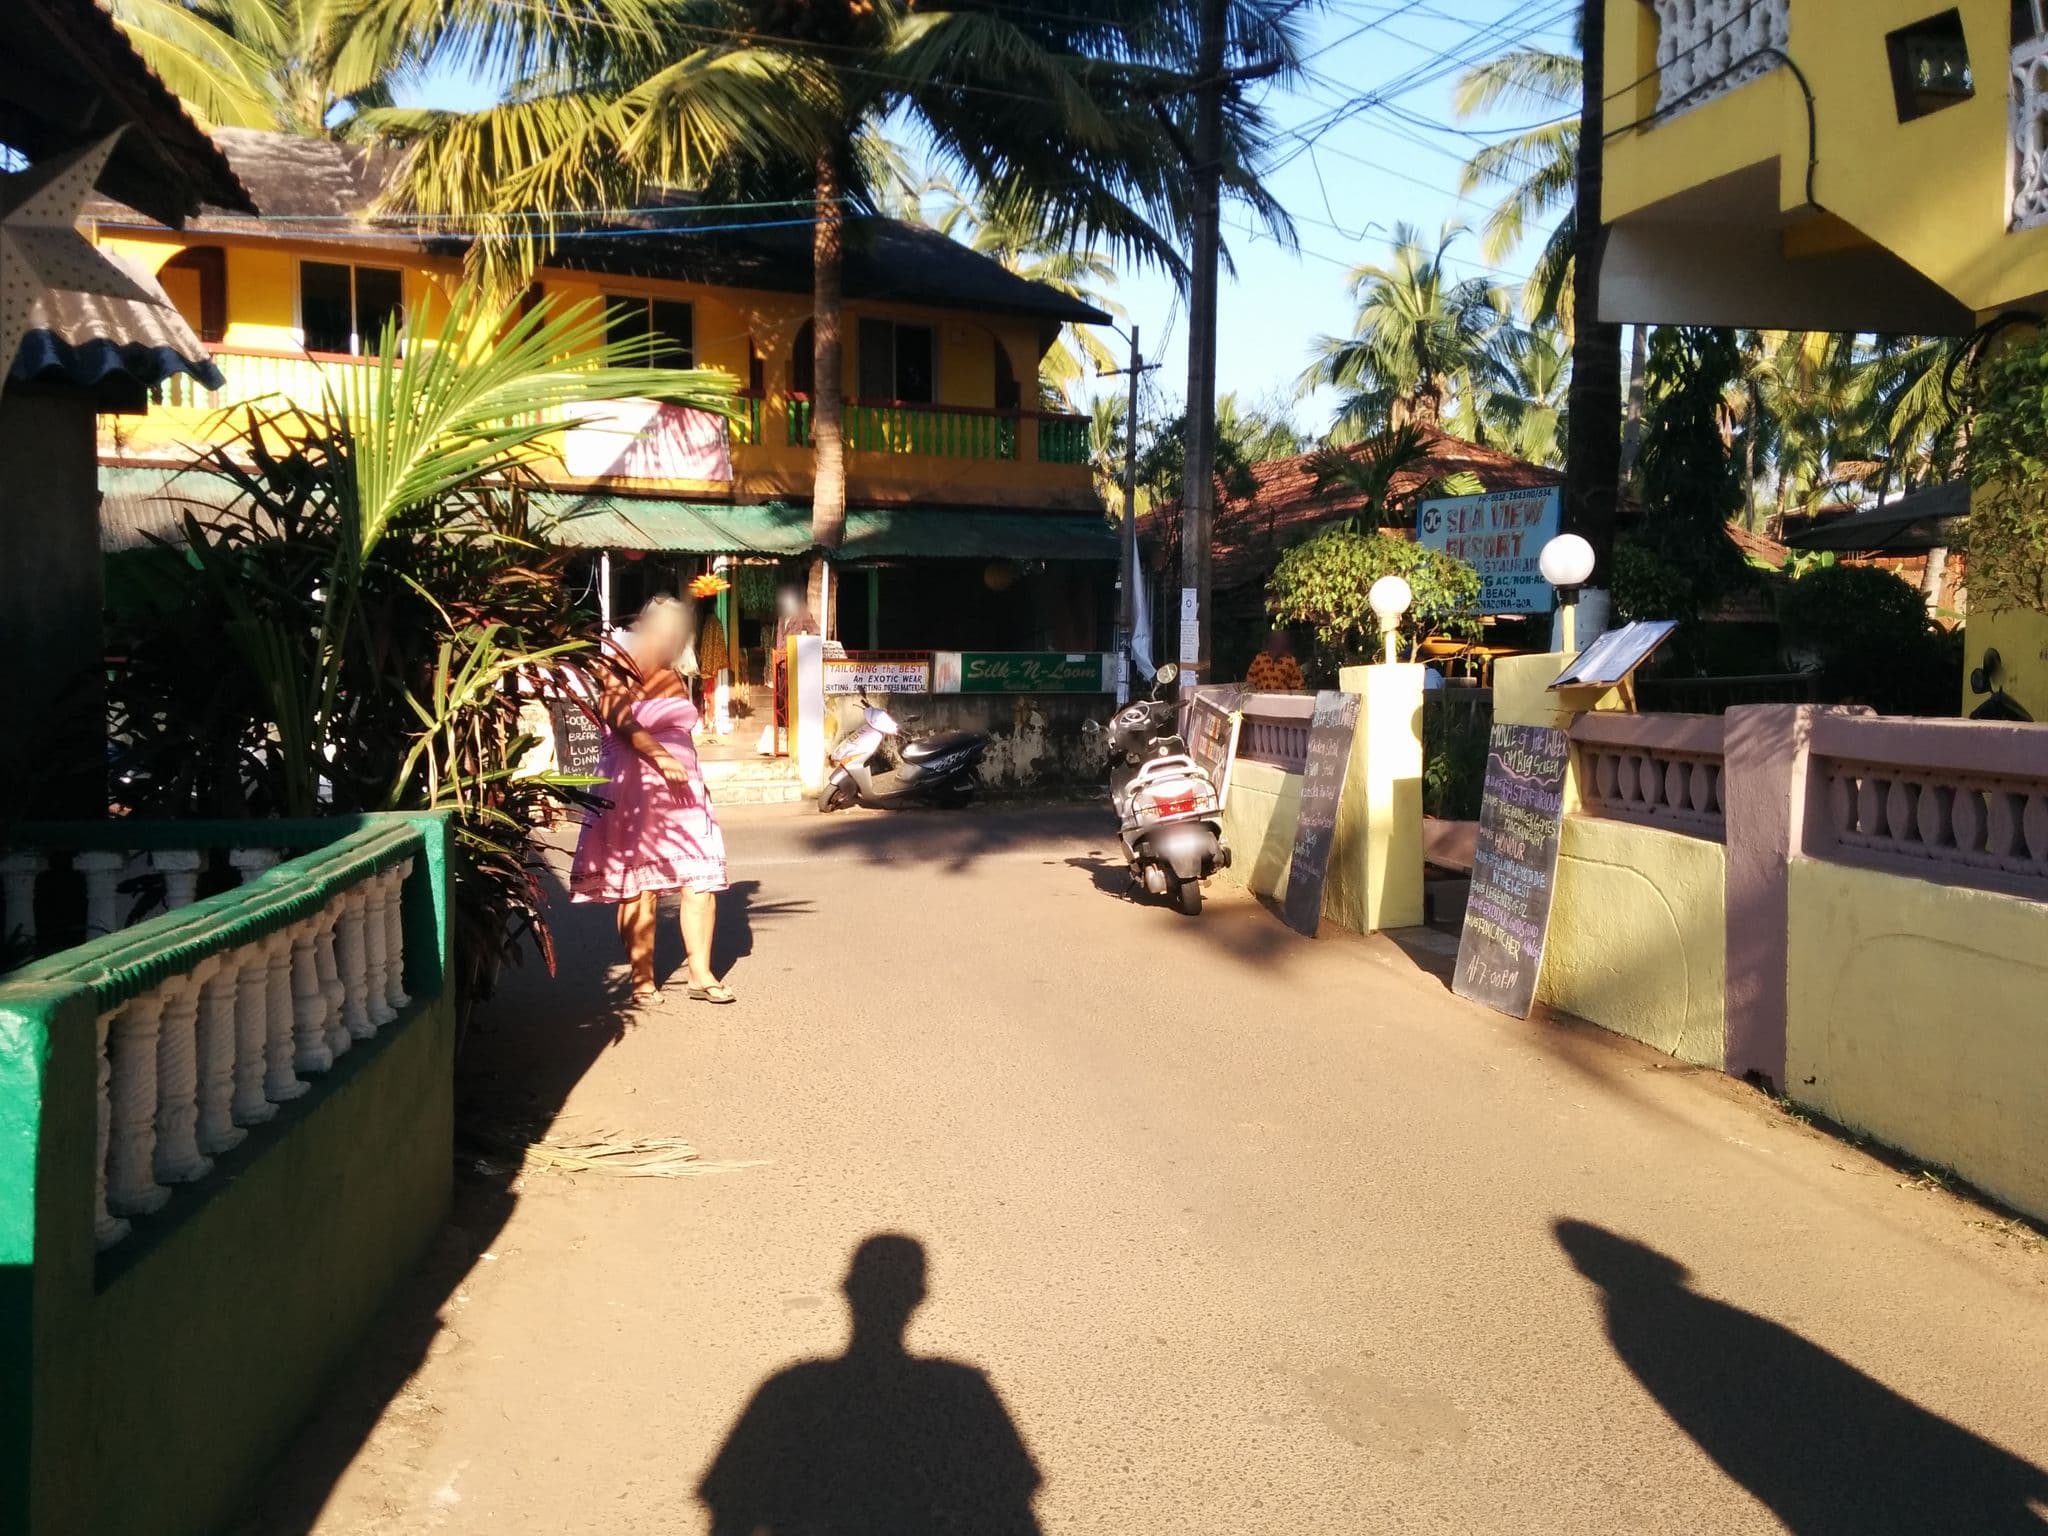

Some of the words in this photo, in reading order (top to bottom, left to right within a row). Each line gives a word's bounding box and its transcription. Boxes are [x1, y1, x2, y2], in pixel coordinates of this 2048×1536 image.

[1486, 588, 1516, 599] BEACH
[830, 664, 878, 673] TAILORING
[883, 665, 896, 673] the
[899, 664, 922, 673] BEST
[853, 675, 863, 683] An
[868, 675, 898, 683] EXOTIC
[902, 675, 923, 683] WEAR
